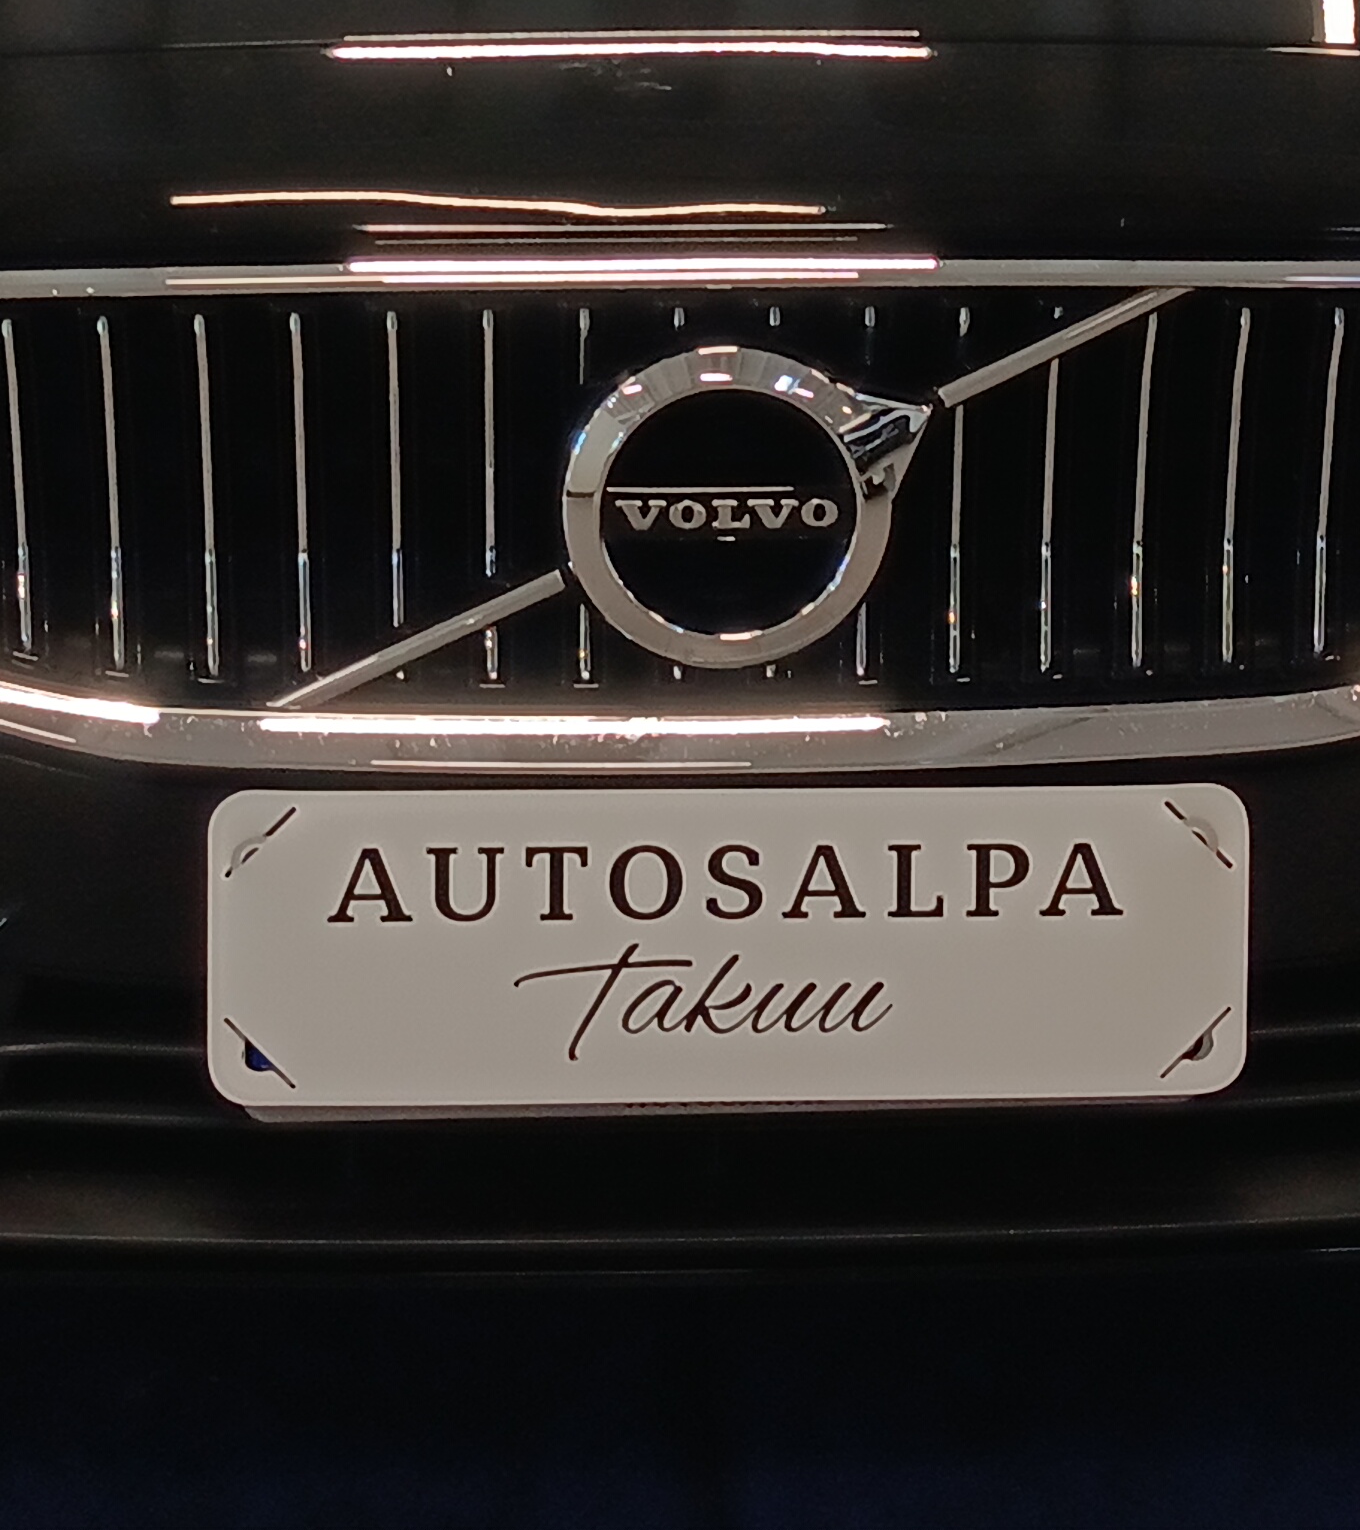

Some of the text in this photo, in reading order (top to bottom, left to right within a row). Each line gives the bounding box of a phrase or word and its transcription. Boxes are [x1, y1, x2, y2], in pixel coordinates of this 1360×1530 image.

[614, 497, 839, 531] VOLVO
[326, 842, 1125, 923] AUTOSALPA
[513, 942, 894, 1063] Takuu
